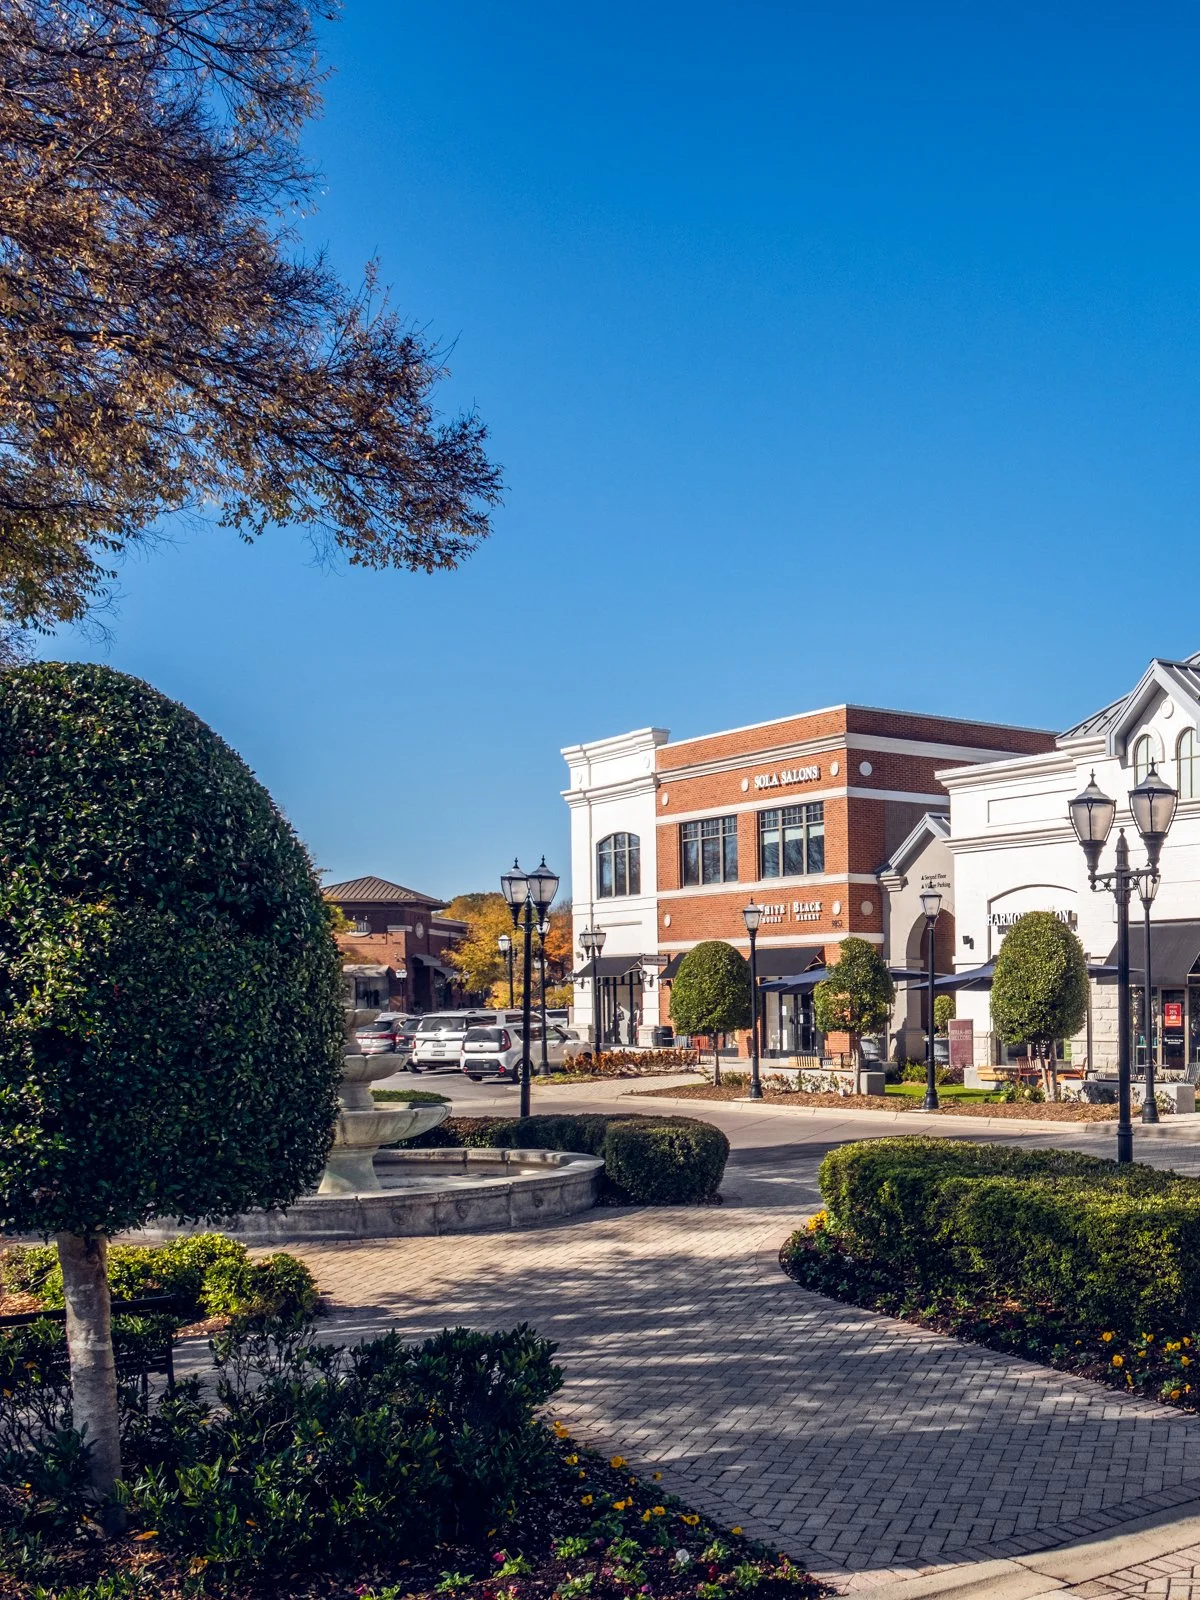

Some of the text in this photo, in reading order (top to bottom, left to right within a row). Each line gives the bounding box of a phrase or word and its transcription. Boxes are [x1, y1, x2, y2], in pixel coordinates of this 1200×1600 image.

[754, 765, 819, 788] SOLA SALONS
[793, 902, 821, 913] BLACK
[796, 913, 820, 921] MARKET
[987, 912, 1024, 926] HARMO
